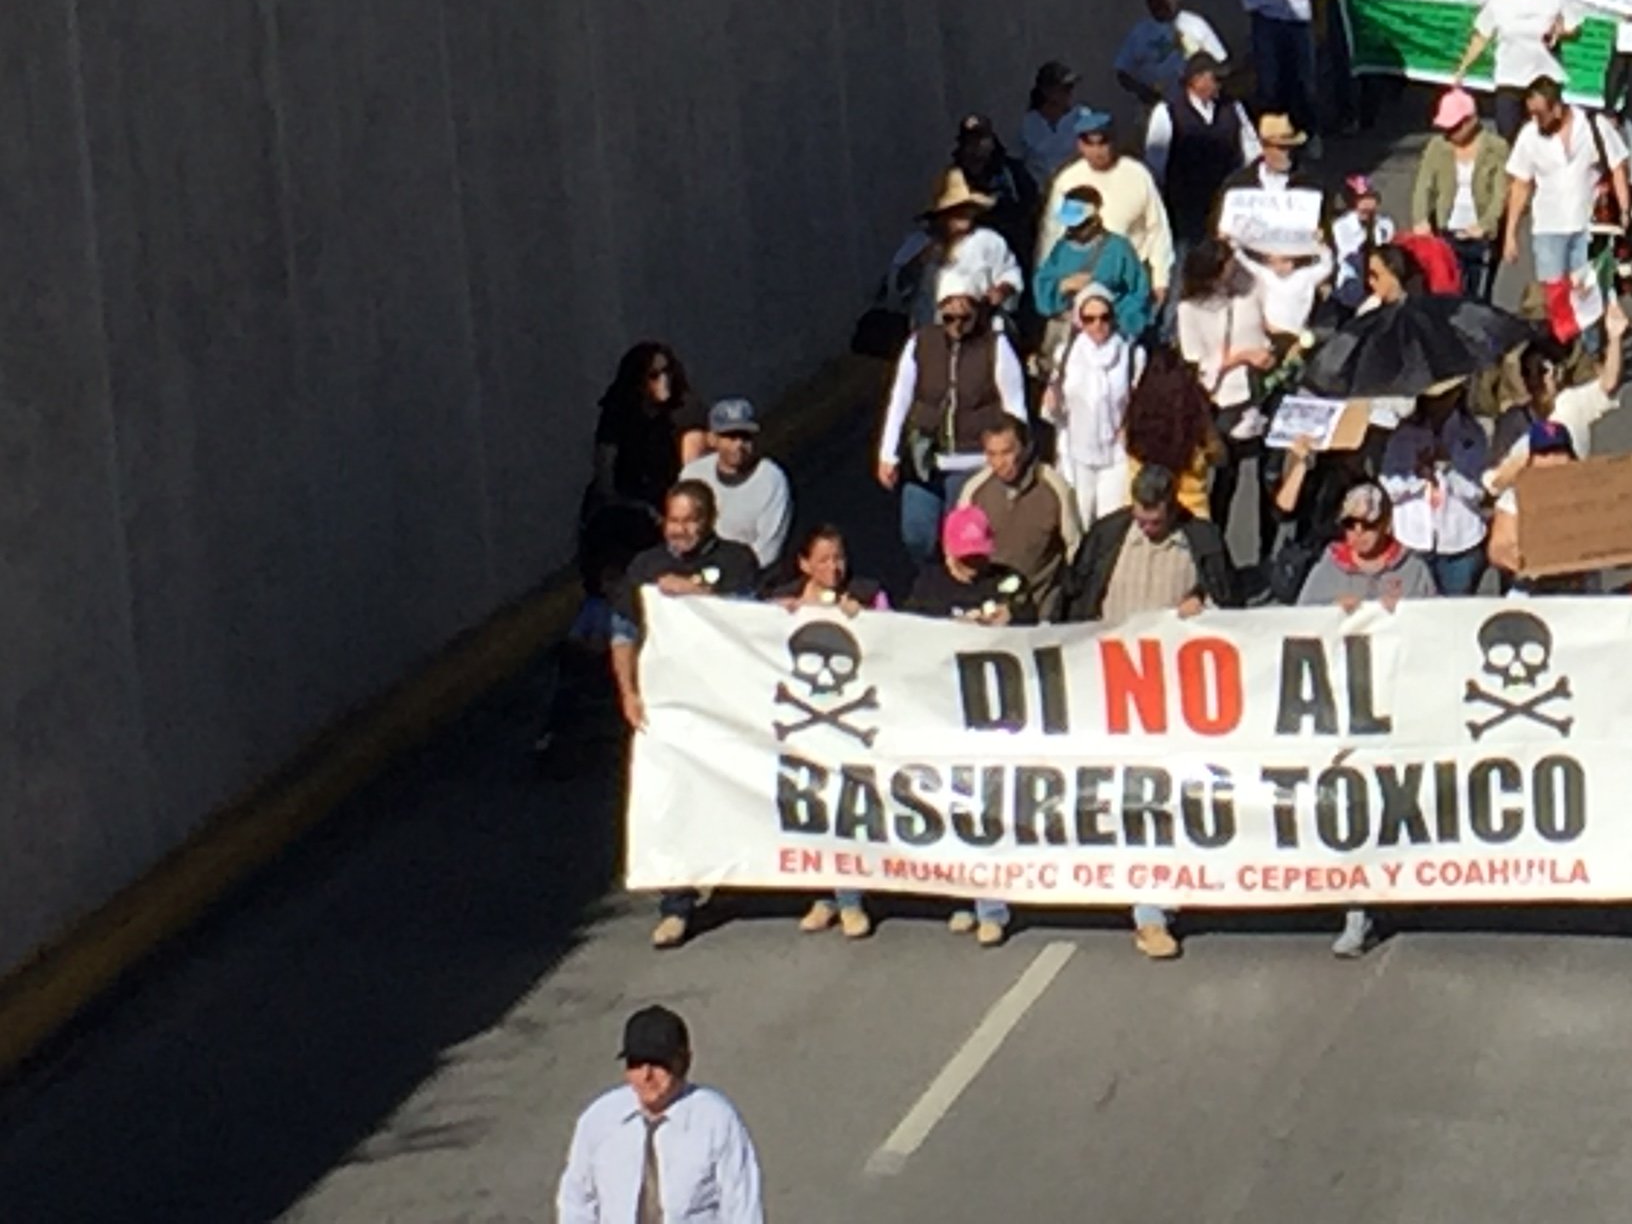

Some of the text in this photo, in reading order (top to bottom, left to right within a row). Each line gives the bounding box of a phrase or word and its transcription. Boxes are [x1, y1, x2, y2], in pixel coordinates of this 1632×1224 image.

[956, 632, 1394, 736] DI NO AL
[776, 747, 1588, 852] BASURERO TÓXICO
[778, 847, 822, 874] EN
[834, 852, 874, 877] EL
[1072, 863, 1115, 889] DE
[1237, 863, 1371, 892] CEPEDA
[1381, 861, 1403, 887] Y
